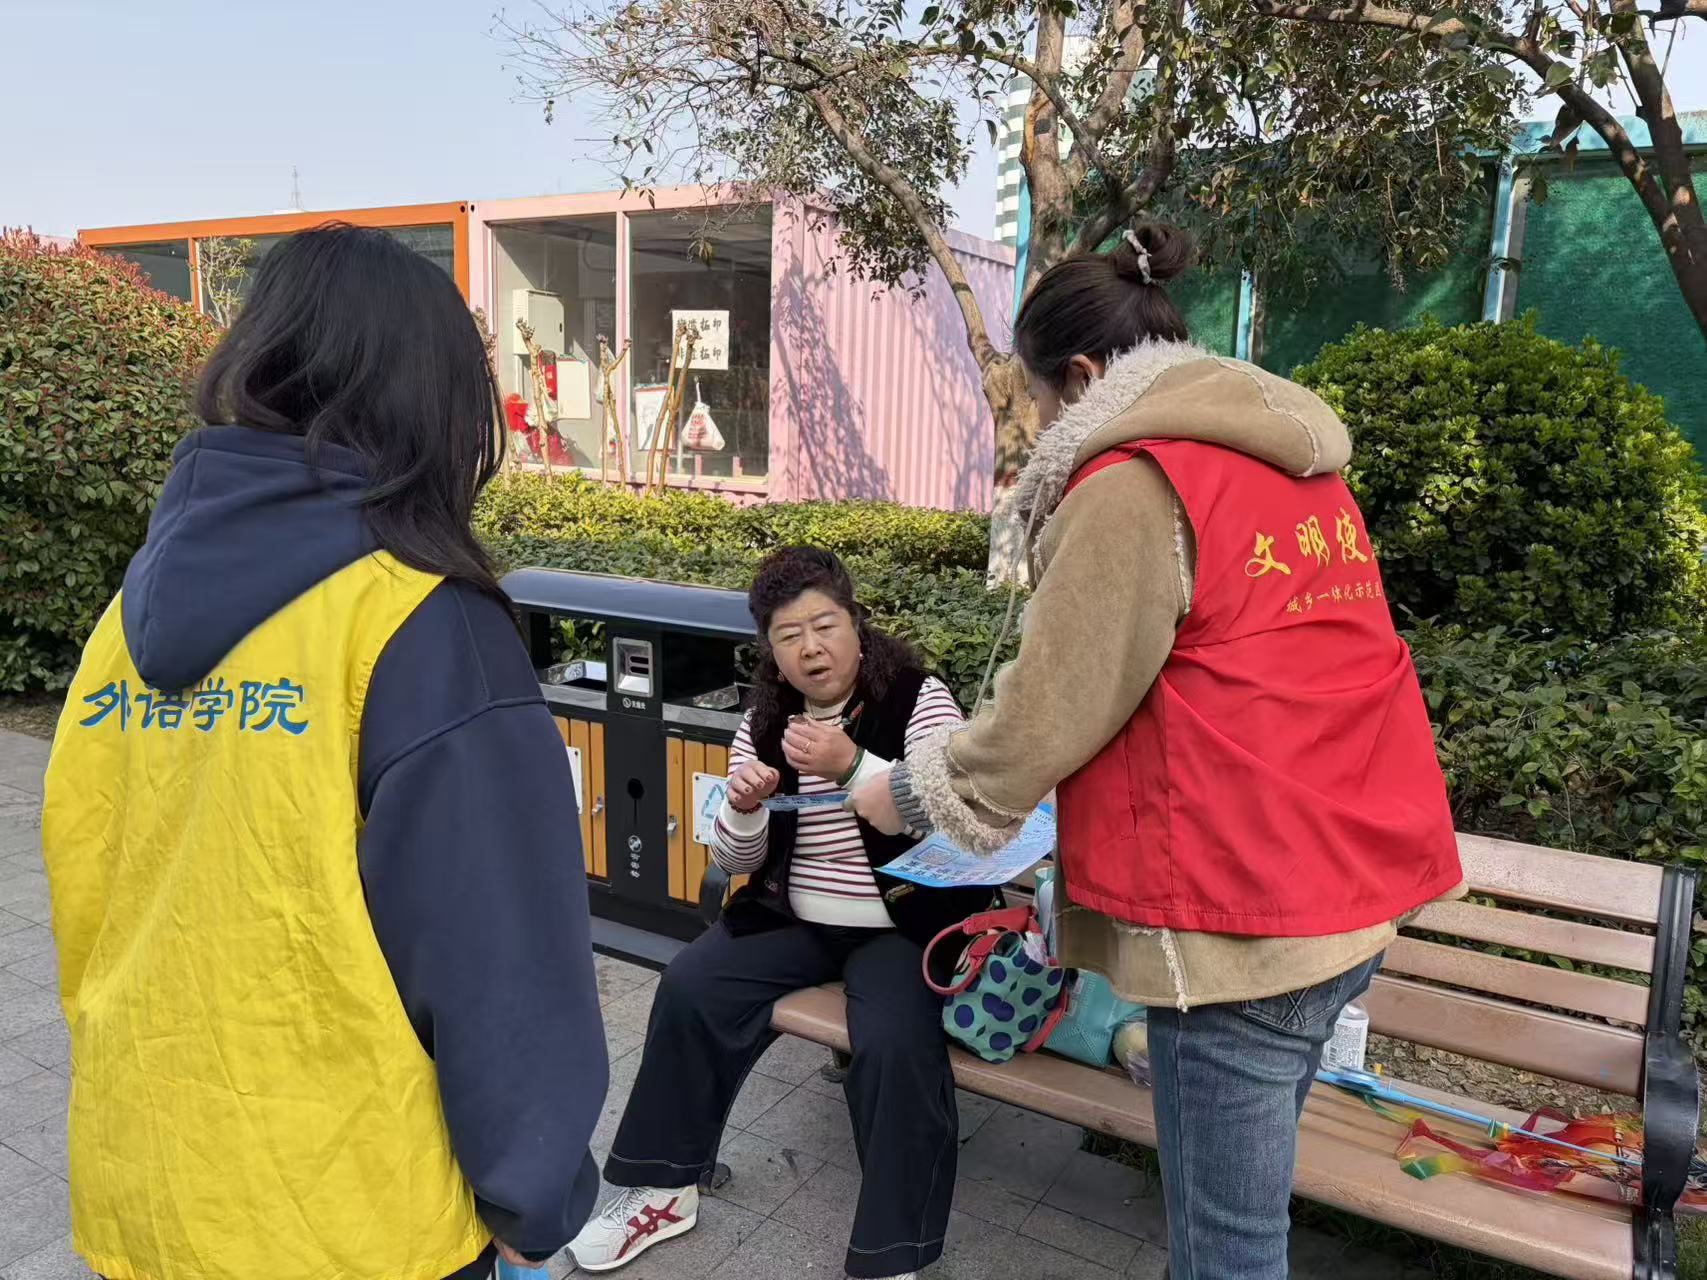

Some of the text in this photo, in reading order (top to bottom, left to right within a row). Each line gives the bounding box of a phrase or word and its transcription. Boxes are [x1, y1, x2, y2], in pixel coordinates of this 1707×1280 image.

[1244, 506, 1376, 578] 文明使
[79, 676, 310, 736] 外语学院
